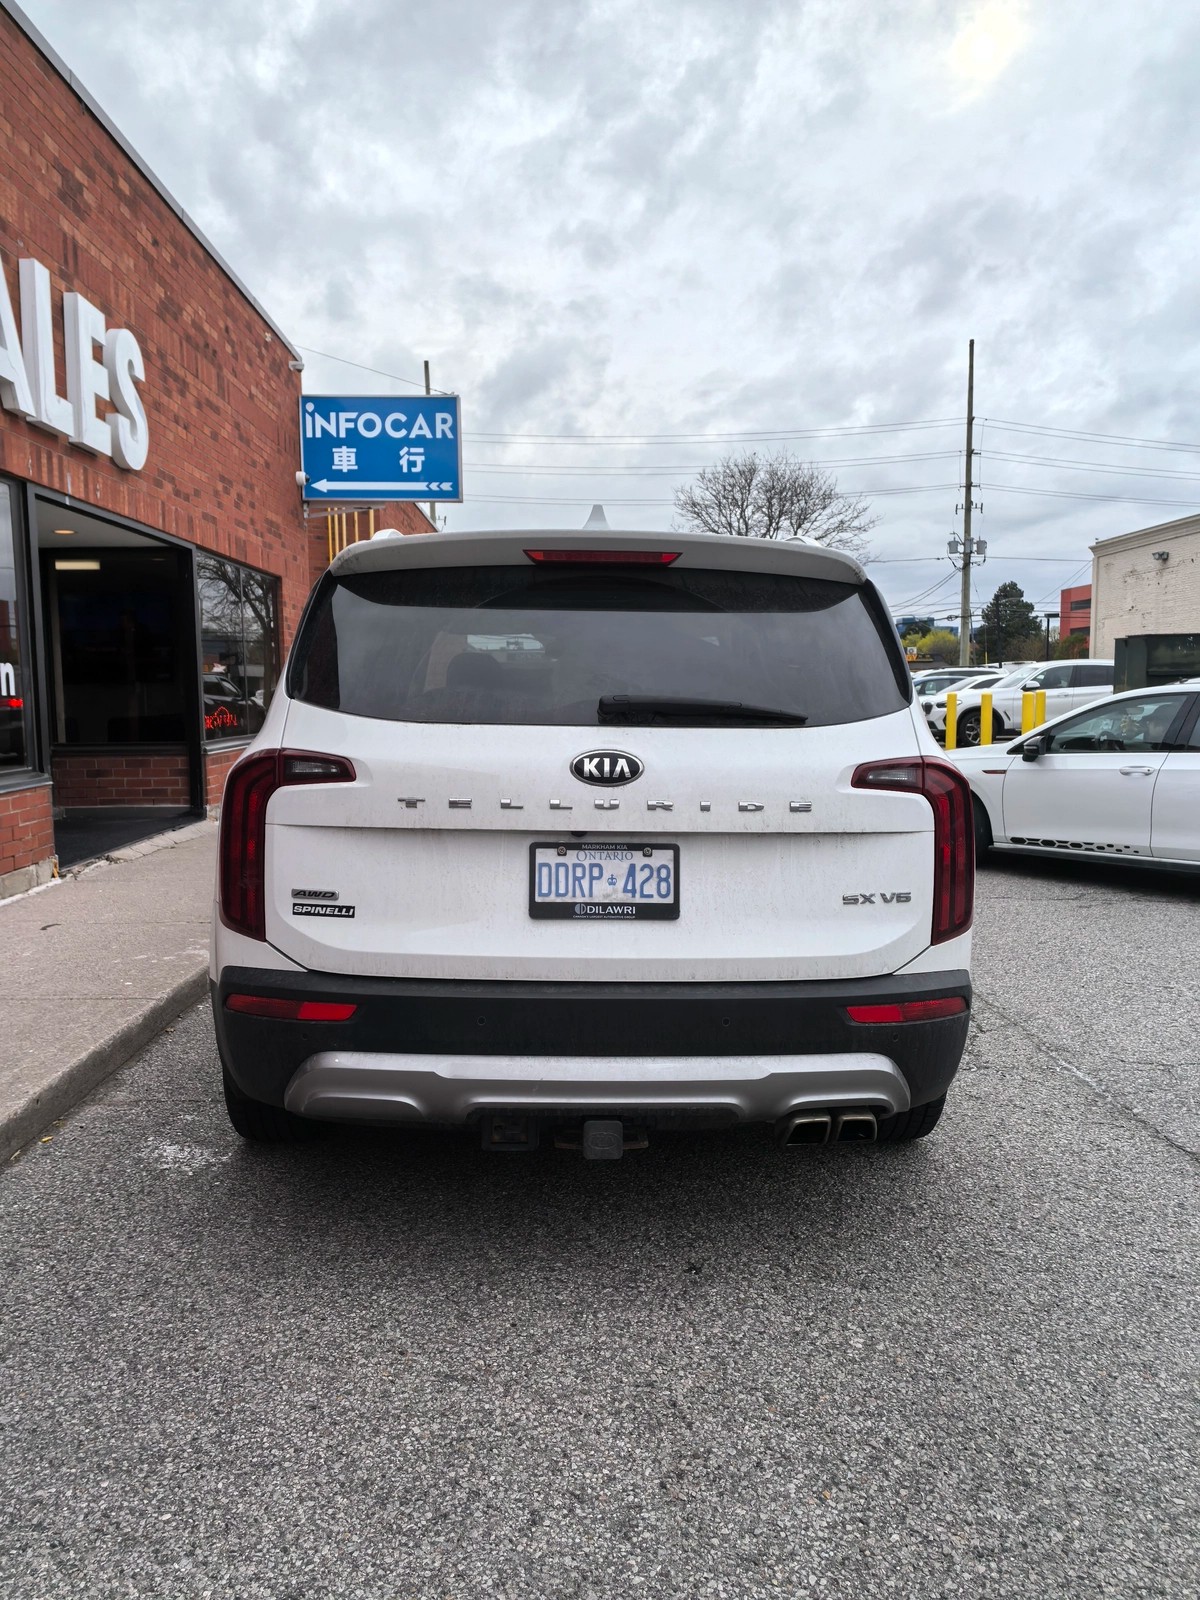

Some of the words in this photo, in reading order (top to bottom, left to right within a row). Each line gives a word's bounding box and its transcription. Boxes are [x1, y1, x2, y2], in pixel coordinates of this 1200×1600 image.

[583, 757, 632, 778] KIA
[397, 797, 812, 812] TELLURIDE
[538, 862, 604, 898] DDRP
[622, 863, 672, 899] 428
[293, 890, 336, 898] AWD
[842, 893, 876, 905] SX
[880, 892, 912, 904] V6
[293, 905, 354, 916] SPINELLI
[587, 905, 636, 915] DILAWRI
